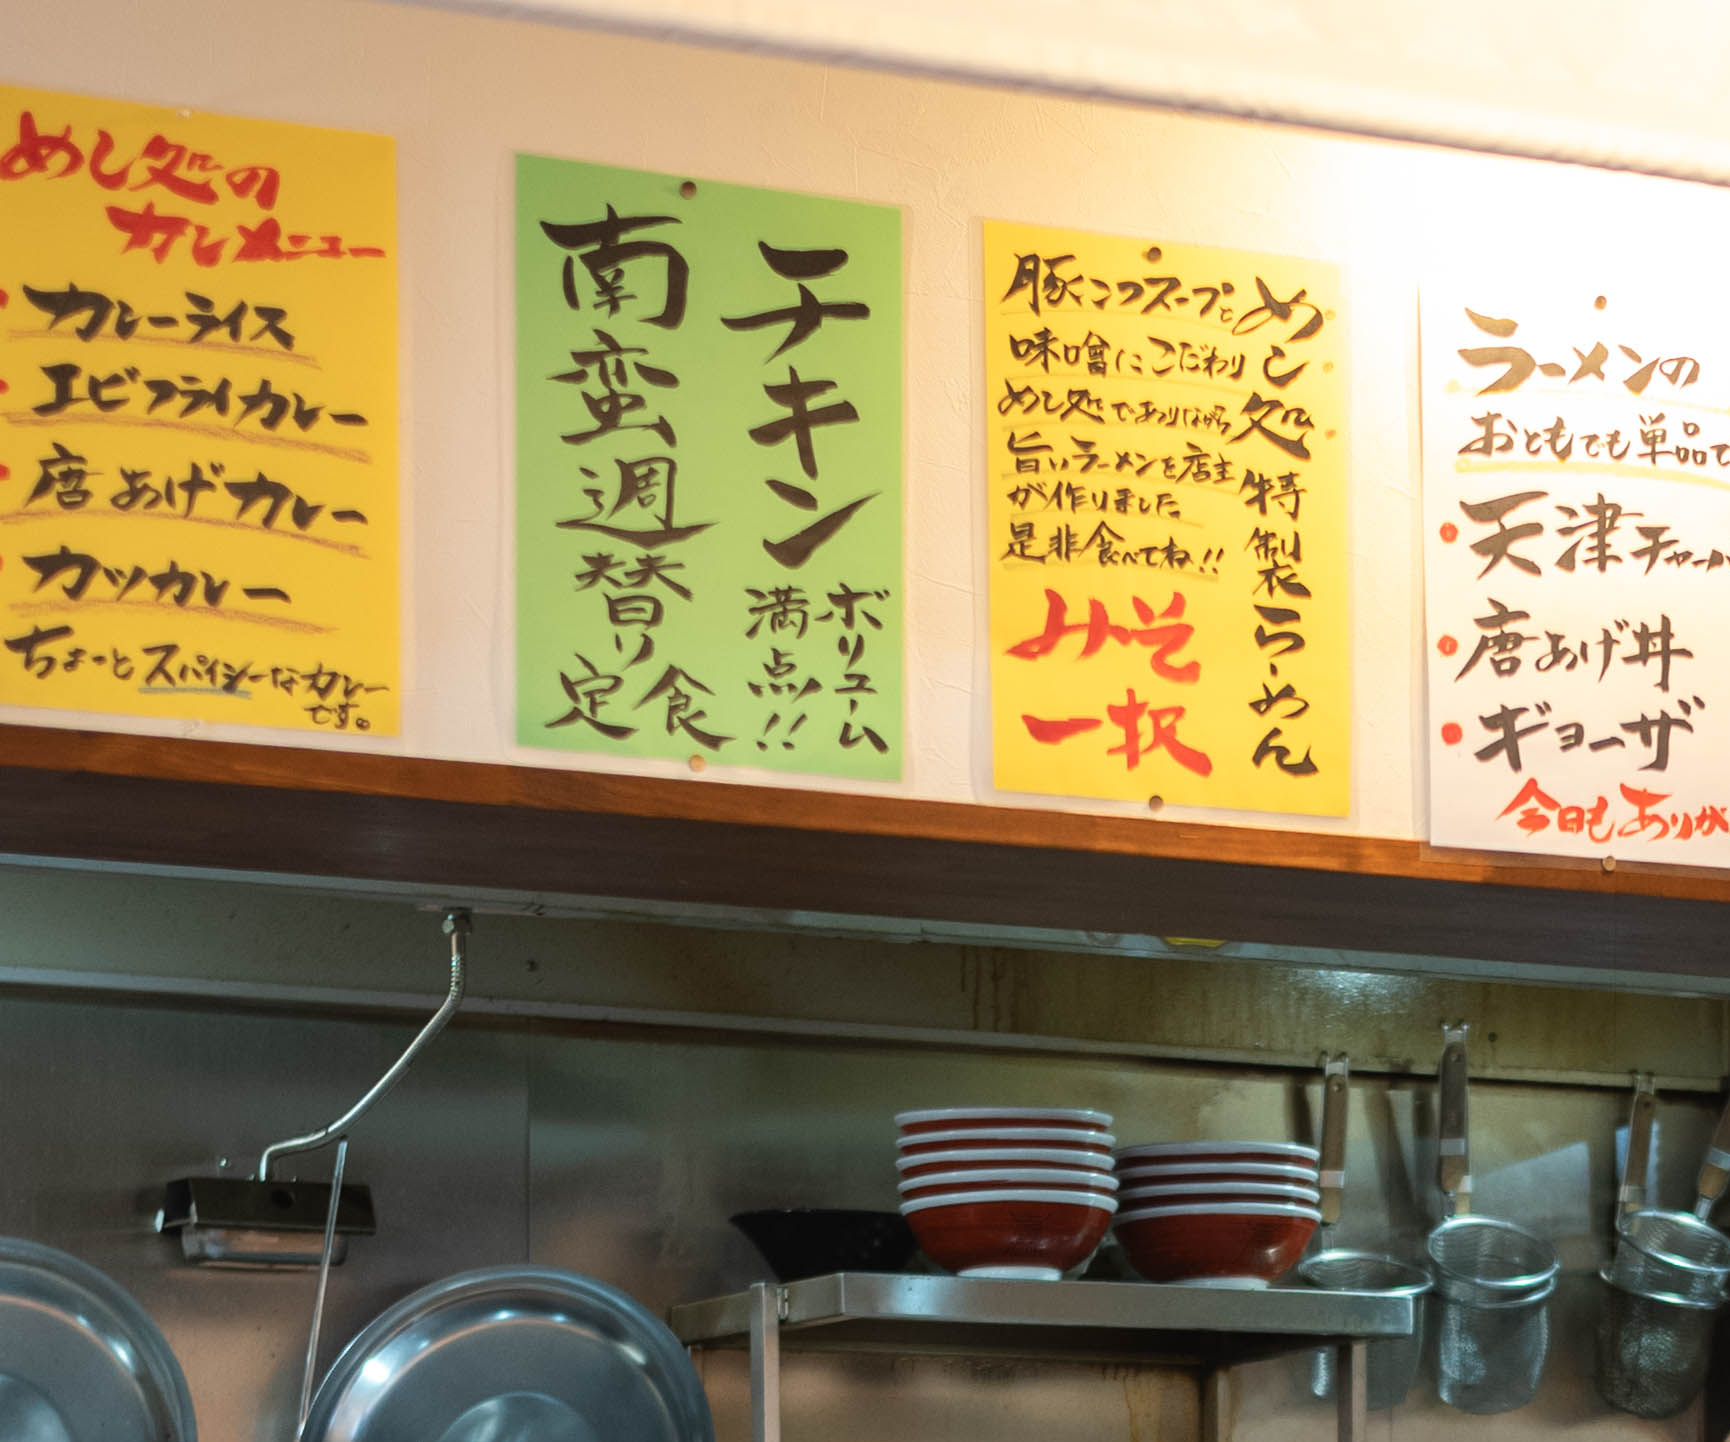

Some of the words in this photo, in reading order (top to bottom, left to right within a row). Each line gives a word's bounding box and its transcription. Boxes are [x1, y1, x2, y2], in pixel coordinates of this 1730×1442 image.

[22, 282, 296, 350] カレーライス
[1457, 306, 1702, 398] ラーメンの
[40, 361, 369, 431] エビフライカレー
[720, 240, 882, 568] チキン
[22, 441, 369, 530] 唐あげカレー
[1007, 431, 1236, 483] 旨いラーメンを店主
[1007, 482, 1182, 518] が作りました
[22, 544, 293, 604] カツカレー
[819, 582, 890, 755] ボリューム
[1453, 596, 1693, 694] 唐あげ丼
[1474, 694, 1706, 773] ギョーザ
